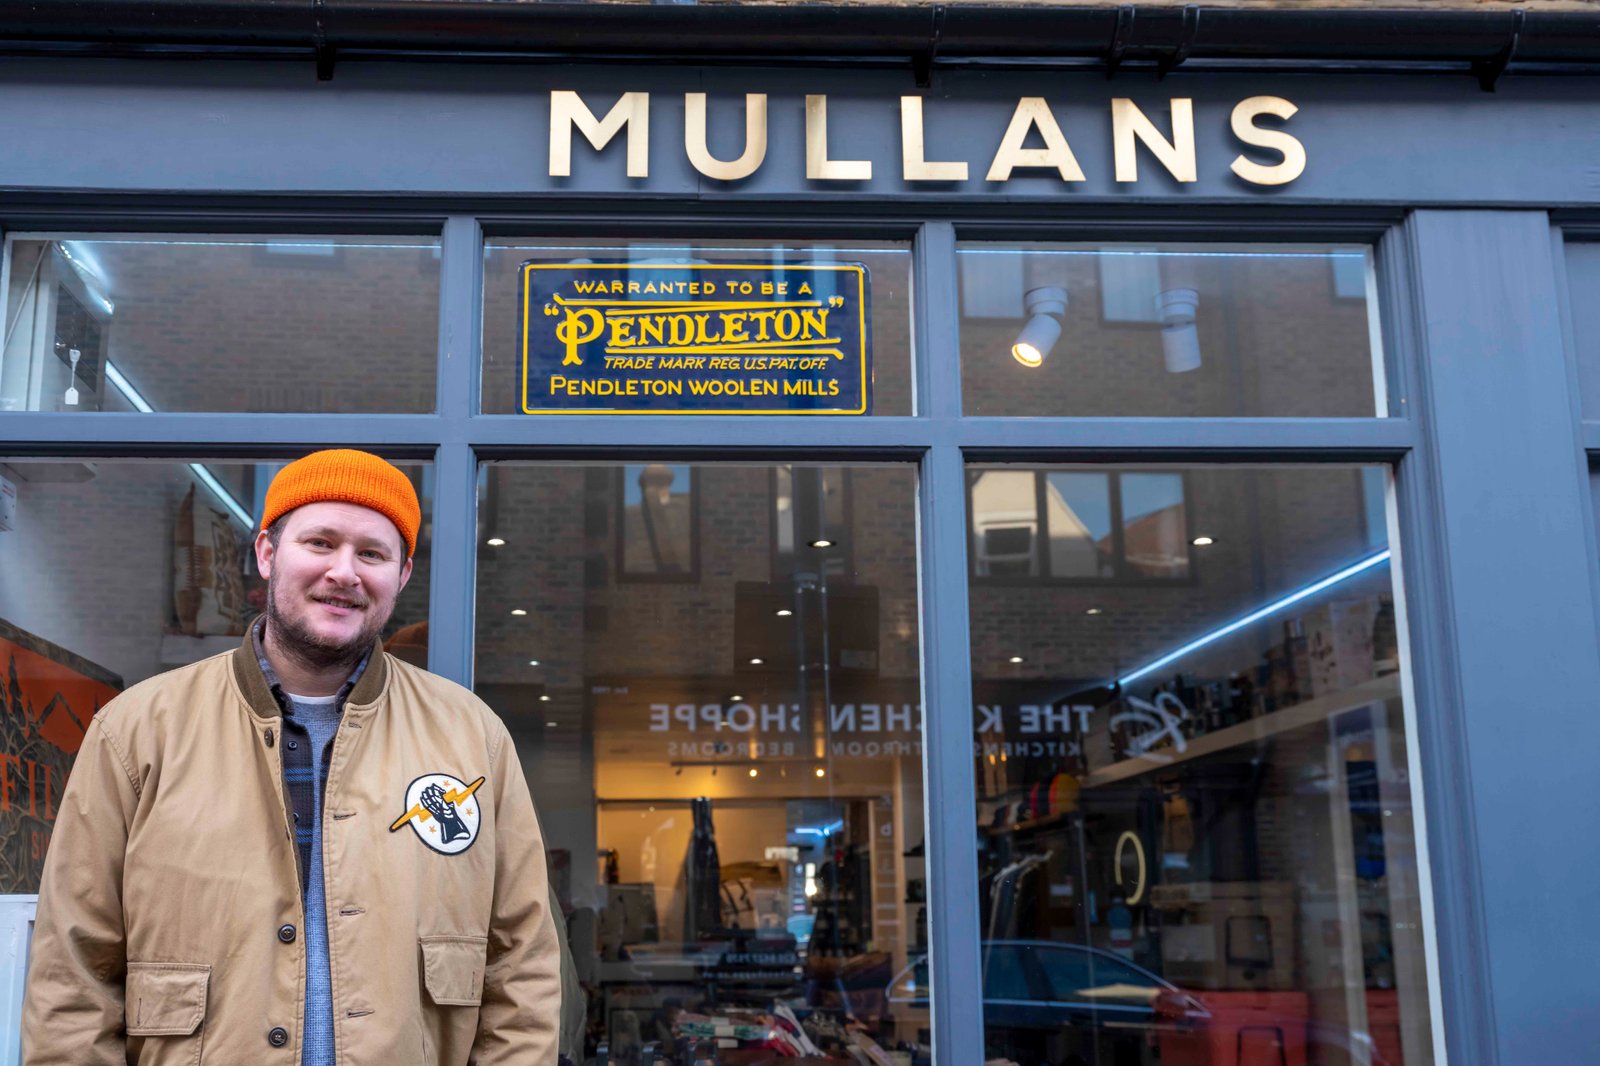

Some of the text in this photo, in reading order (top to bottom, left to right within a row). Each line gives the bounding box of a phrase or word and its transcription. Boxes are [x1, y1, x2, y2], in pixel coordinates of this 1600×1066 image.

[548, 90, 1307, 187] MULLANS
[574, 281, 812, 295] WARRANTED TO BE A
[605, 357, 653, 370] TRADE
[658, 357, 706, 370] MARK
[550, 376, 840, 396] PENDLETON WOOLEN MILLS
[0, 753, 69, 820] FIL
